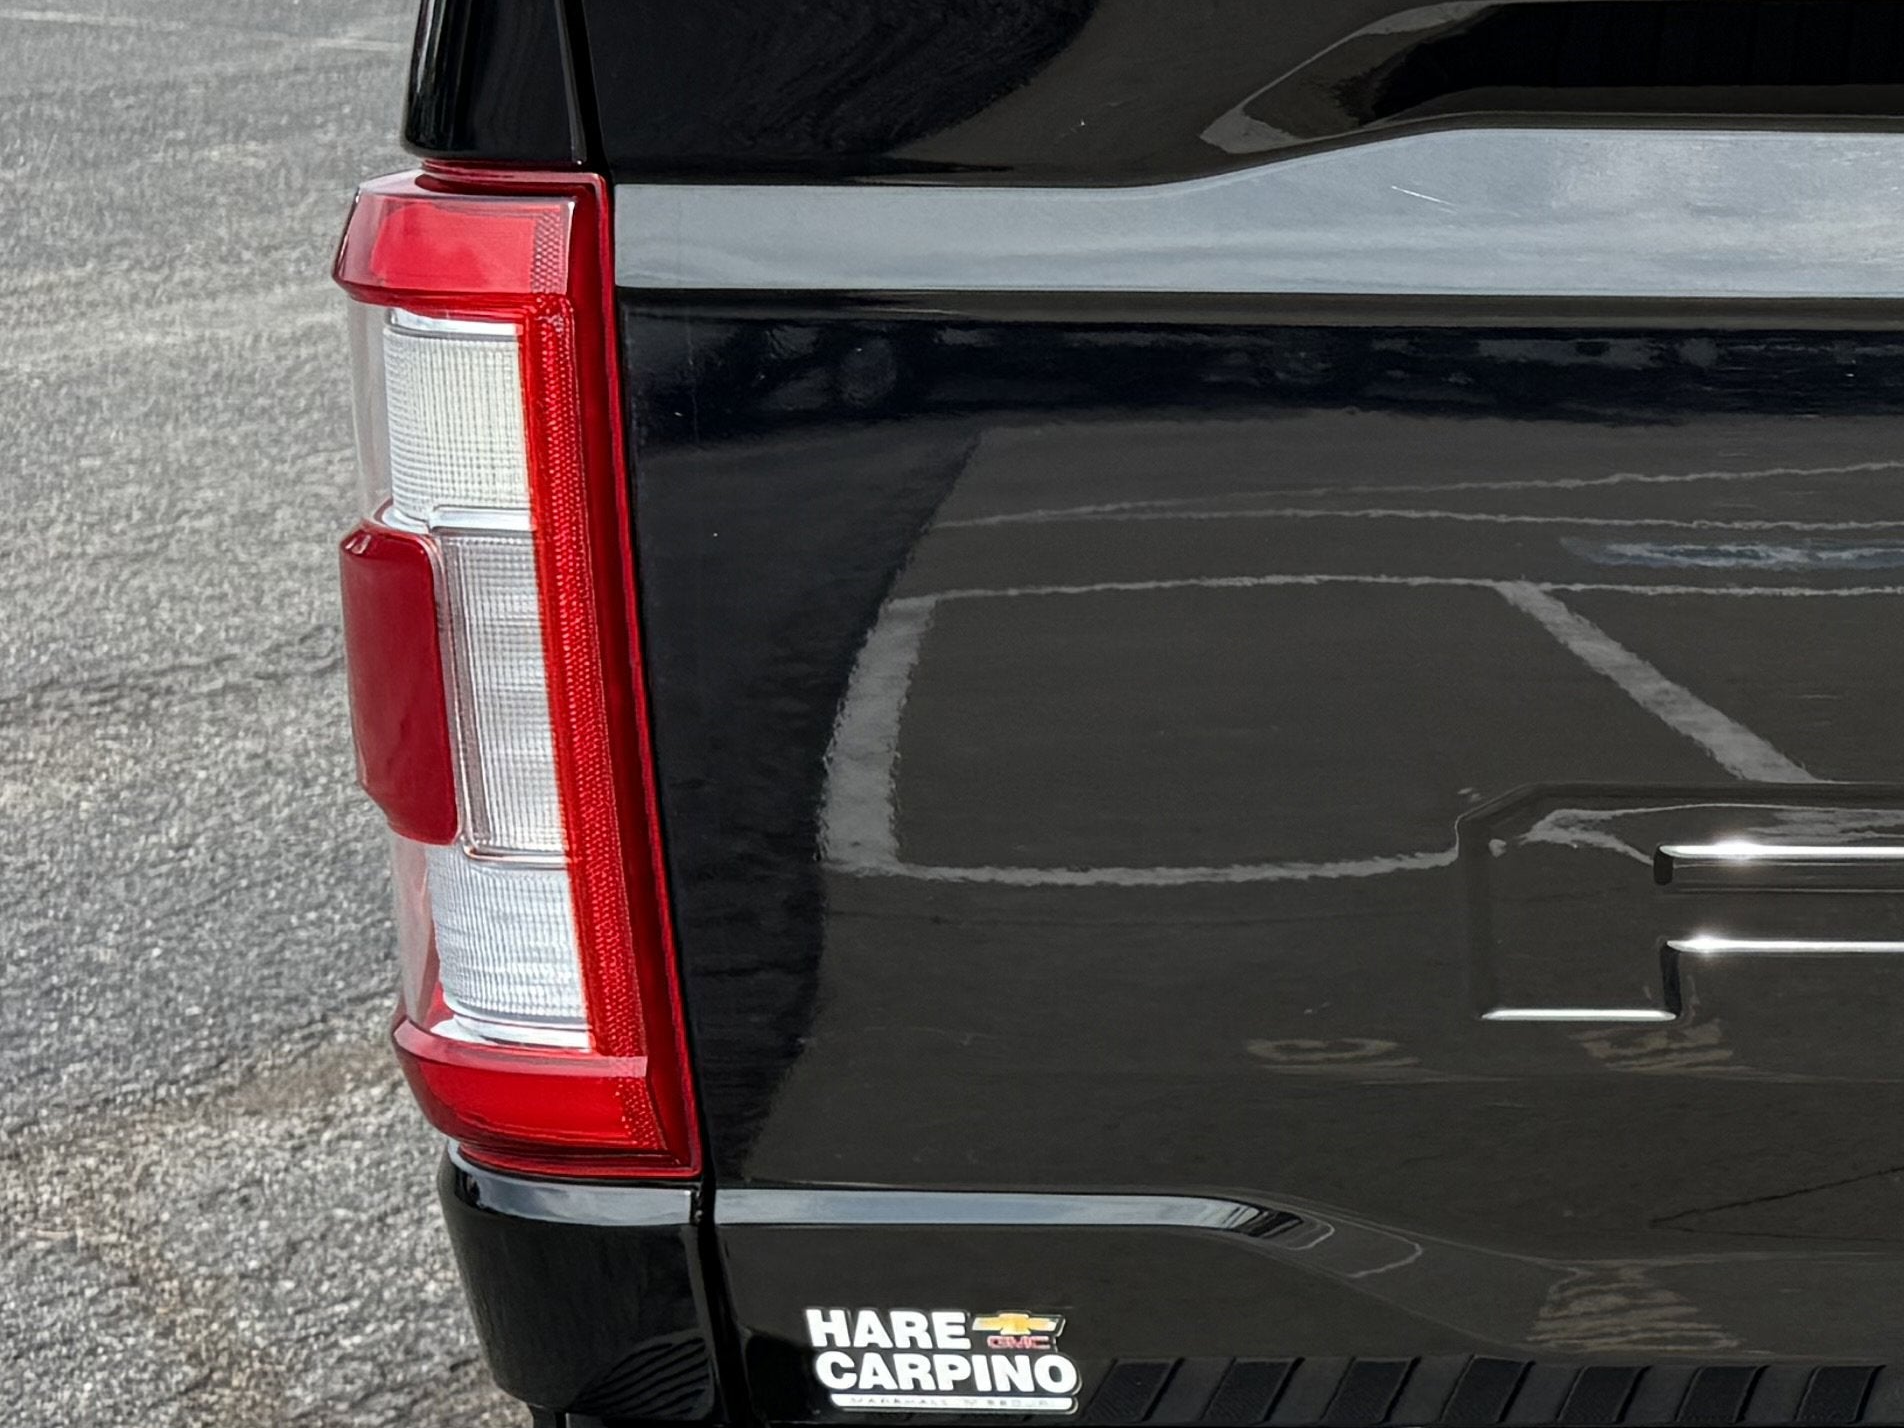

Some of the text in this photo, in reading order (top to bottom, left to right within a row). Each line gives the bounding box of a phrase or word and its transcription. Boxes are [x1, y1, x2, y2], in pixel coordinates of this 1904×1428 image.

[805, 1309, 971, 1349] HARE
[987, 1335, 1050, 1350] GMC
[815, 1351, 1077, 1394] CARPINO
